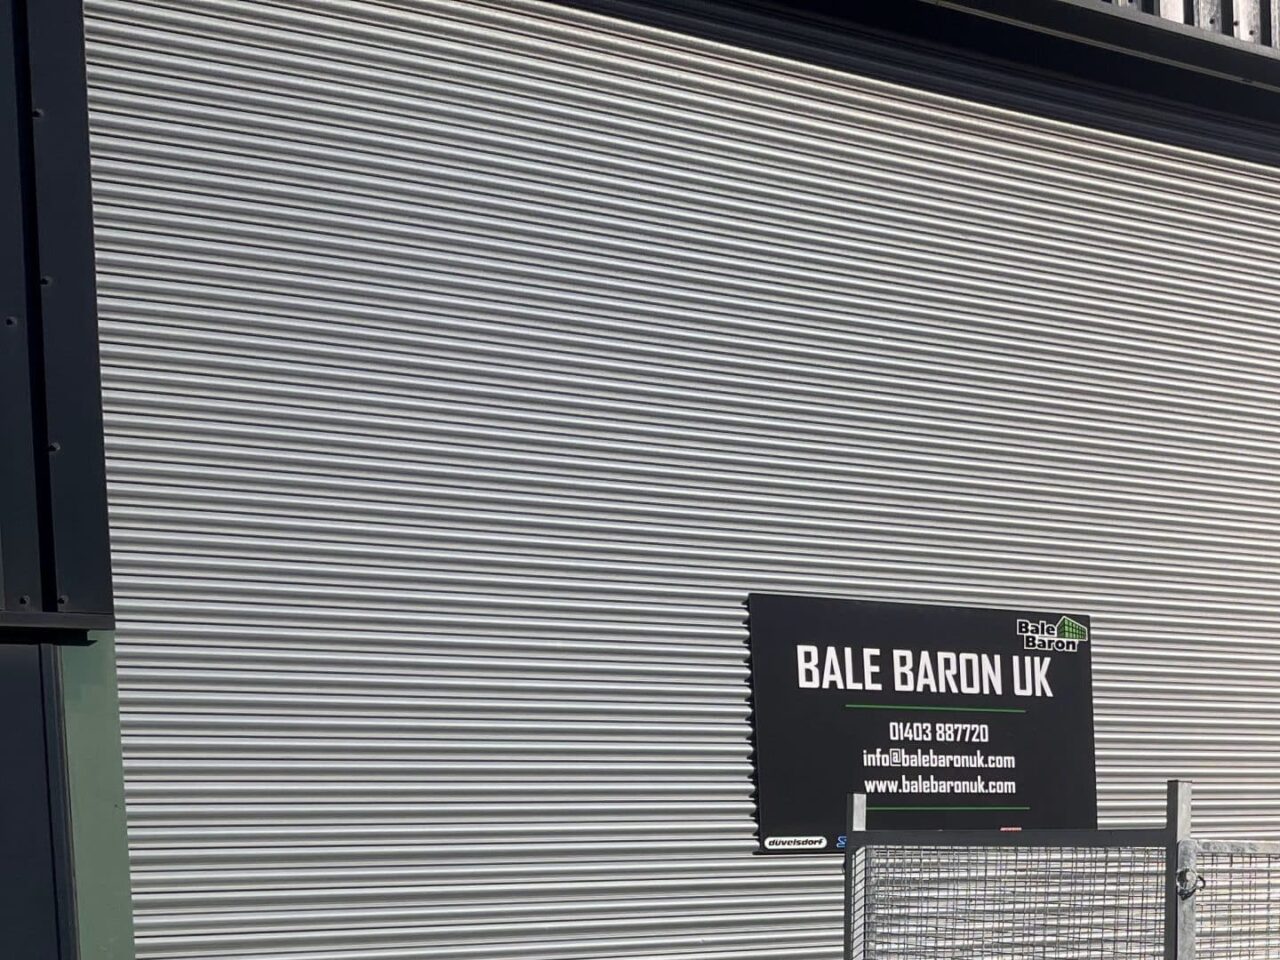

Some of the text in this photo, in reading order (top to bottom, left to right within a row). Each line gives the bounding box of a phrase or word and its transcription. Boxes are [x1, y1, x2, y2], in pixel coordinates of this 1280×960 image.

[1017, 619, 1057, 636] Bale
[1024, 635, 1077, 652] Baron
[797, 645, 1054, 698] BALE BARON UK
[889, 722, 990, 743] 01403 887720
[863, 748, 1016, 768] info@balebaronuk.com
[864, 774, 1016, 794] www.balebaronuk.com
[768, 838, 824, 846] düvelsdorf
